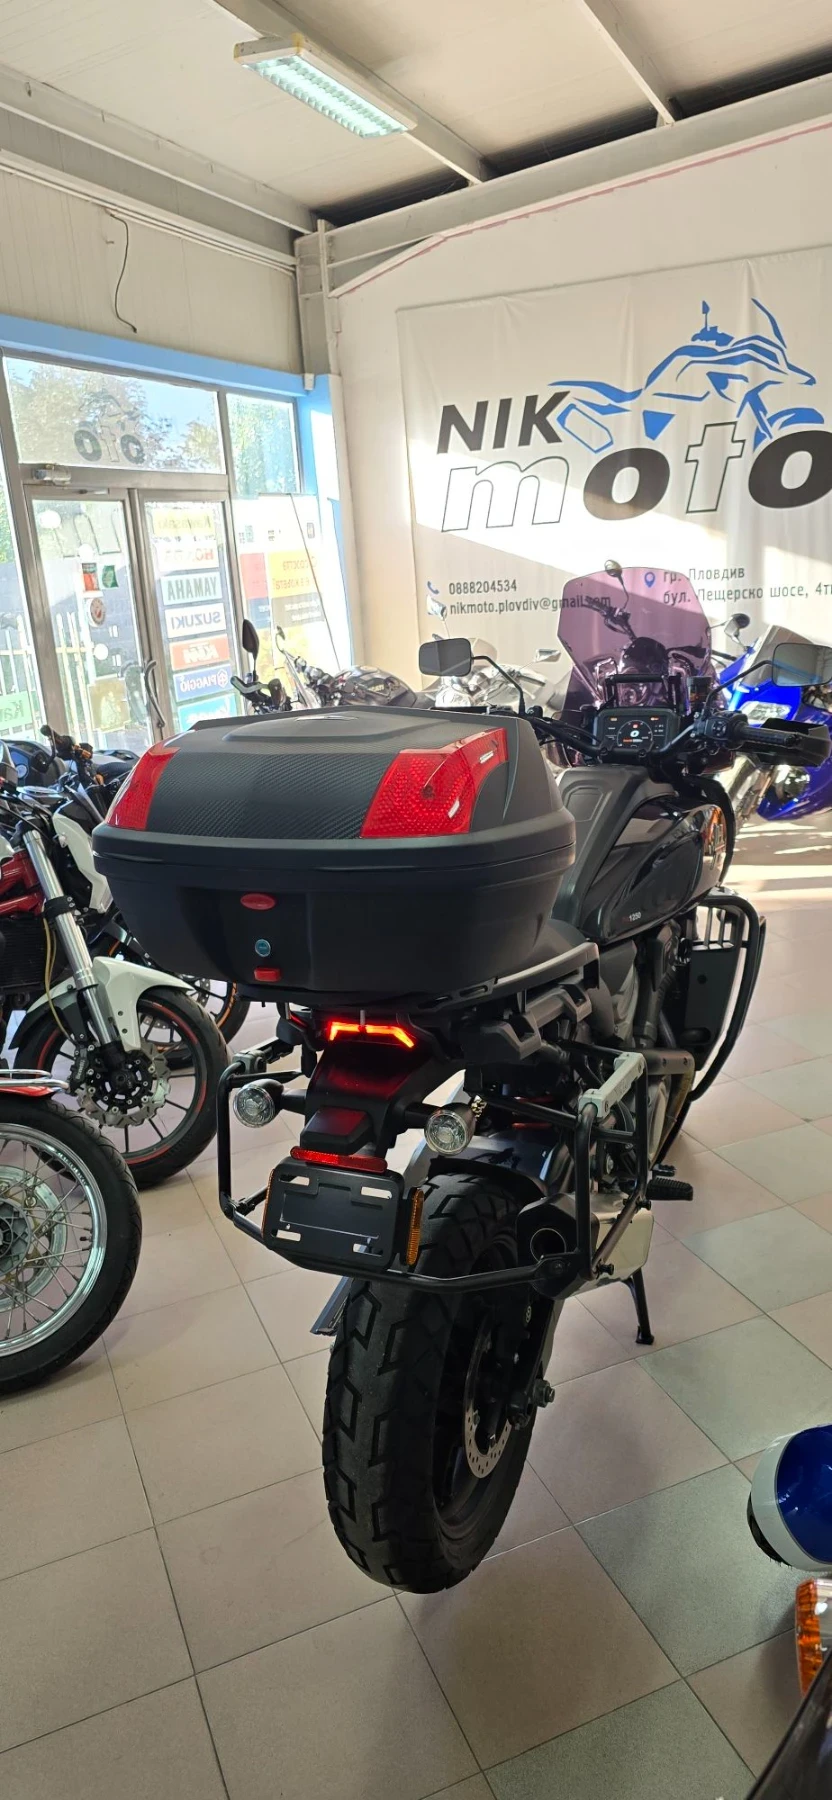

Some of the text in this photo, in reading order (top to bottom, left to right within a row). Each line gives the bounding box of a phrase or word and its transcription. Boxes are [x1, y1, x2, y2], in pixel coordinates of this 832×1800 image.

[436, 390, 571, 454] NIK
[441, 421, 832, 533] moto
[663, 567, 745, 584] гр. Пловдив
[448, 579, 517, 595] 0888204534
[663, 591, 691, 606] бул.
[697, 587, 764, 602] Пещерско
[769, 588, 809, 599] шосе,
[450, 595, 611, 615] nikmoto.plovdiv@gmailom
